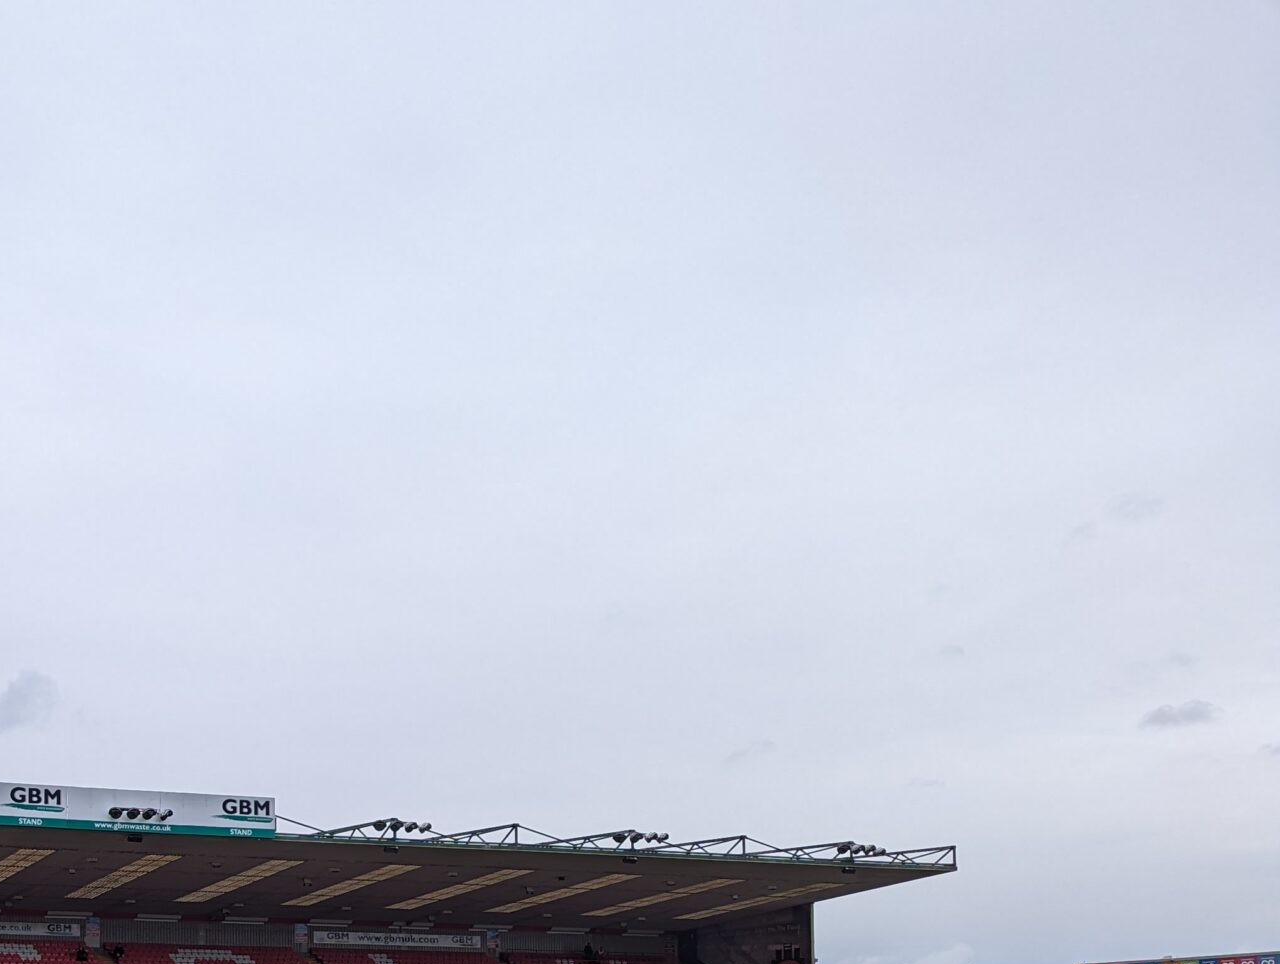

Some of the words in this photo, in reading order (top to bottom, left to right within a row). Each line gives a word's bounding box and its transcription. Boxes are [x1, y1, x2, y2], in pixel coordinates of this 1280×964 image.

[10, 787, 62, 805] GBM
[222, 798, 271, 816] GBM
[18, 818, 43, 826] STAND
[94, 821, 172, 832] www.gbmwaste.co.uk
[230, 828, 253, 836] STAND
[47, 923, 72, 933] GBM
[327, 932, 350, 941] GBM
[358, 934, 439, 945] www.gbmuk.com
[451, 936, 474, 945] GBM
